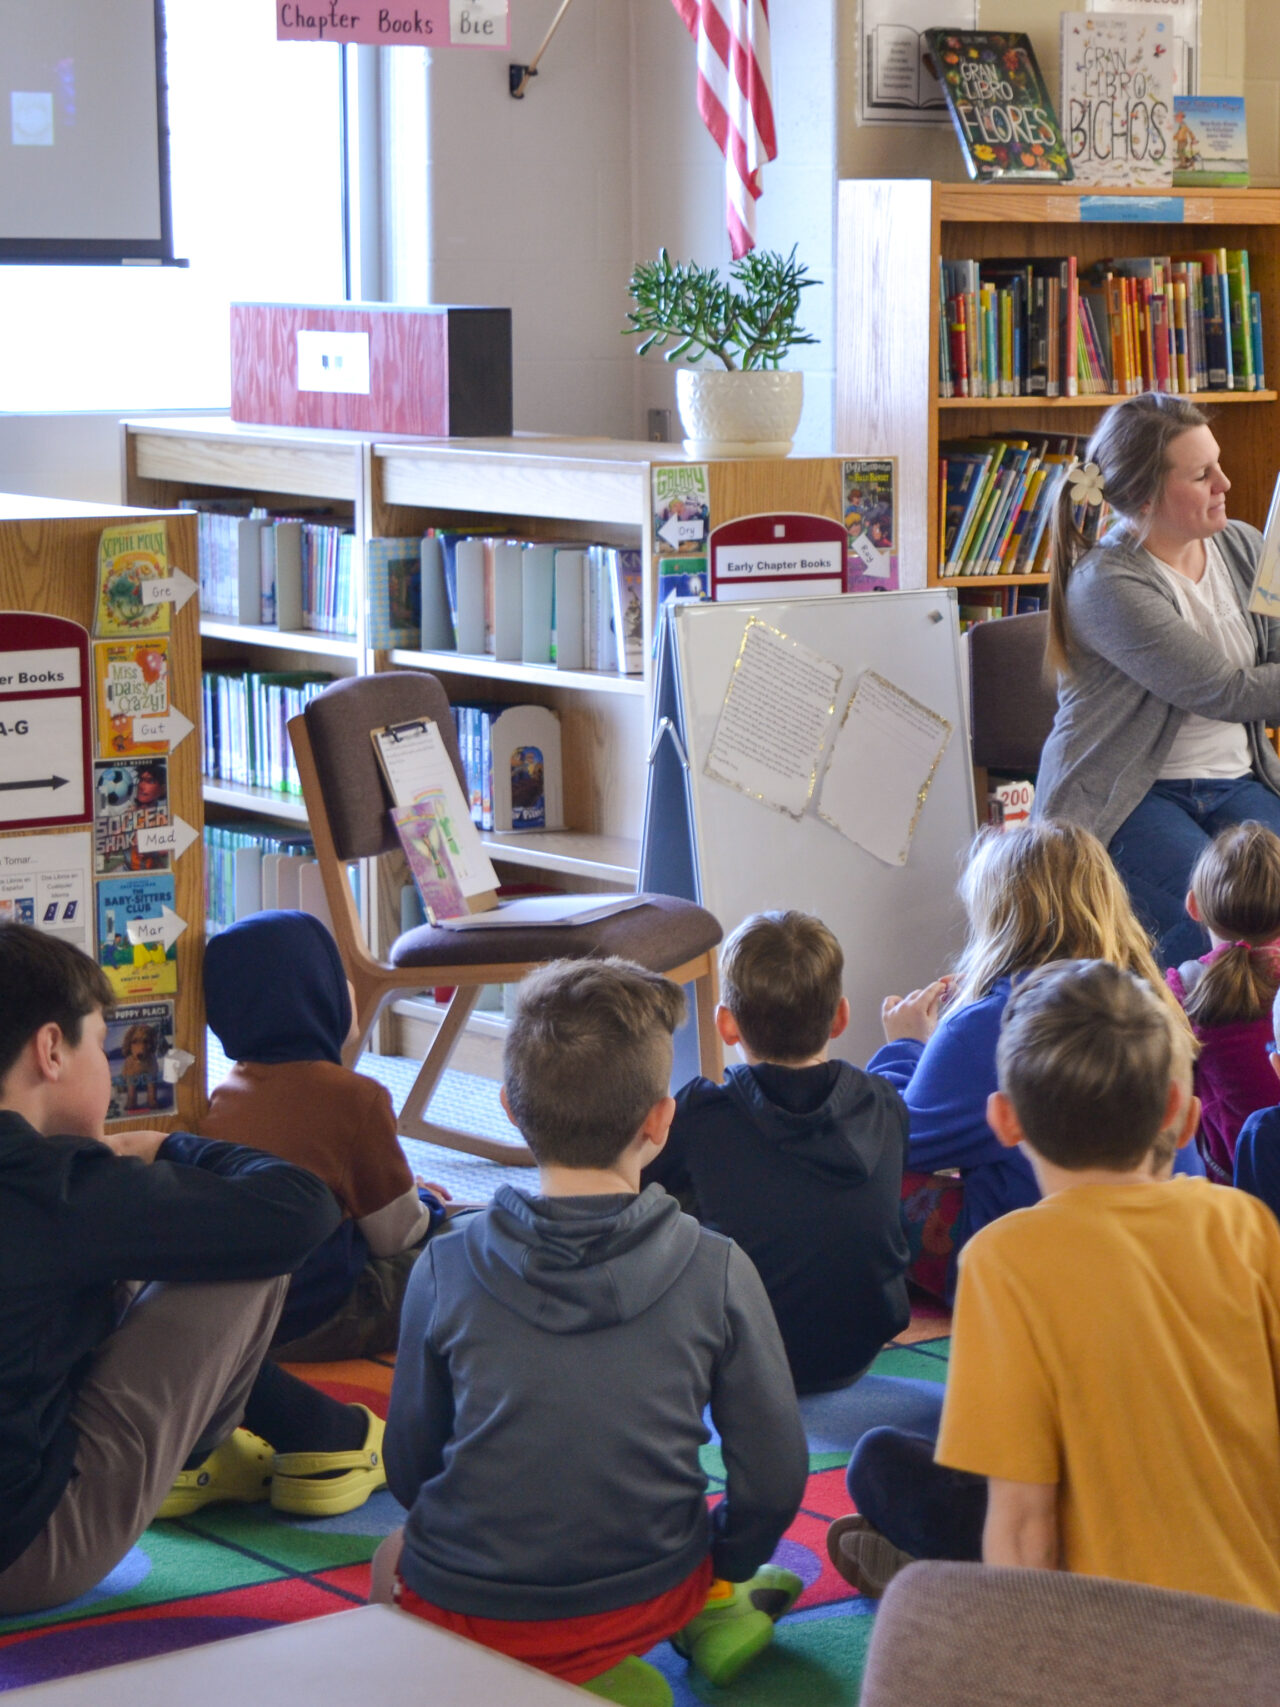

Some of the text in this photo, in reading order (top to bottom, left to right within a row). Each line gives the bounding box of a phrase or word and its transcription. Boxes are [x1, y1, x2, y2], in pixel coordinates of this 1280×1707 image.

[281, 3, 433, 38] Chapter Books
[460, 10, 494, 35] Bie
[1083, 46, 1128, 71] GRAN
[960, 62, 998, 81] GRAN
[963, 80, 1014, 101] LIBRO
[1084, 71, 1147, 99] LIBRO
[958, 105, 1056, 146] FLORES
[1070, 98, 1169, 163] BICHOS
[657, 466, 706, 496] GALAXY
[727, 558, 832, 575] Early Chapter Books
[152, 587, 172, 598] Gre
[18, 670, 65, 684] Books
[112, 665, 138, 680] Miss
[115, 681, 150, 697] Daisy
[119, 694, 166, 713] Crazy!
[141, 725, 165, 736] Gut
[1001, 787, 1030, 807] 200
[96, 806, 169, 837] SOCCER
[146, 830, 177, 846] Mad
[104, 891, 172, 907] BABY-SITTERS
[126, 903, 151, 914] CLUB
[138, 925, 165, 938] Mar
[115, 1007, 166, 1020] PUPPY PLACE
